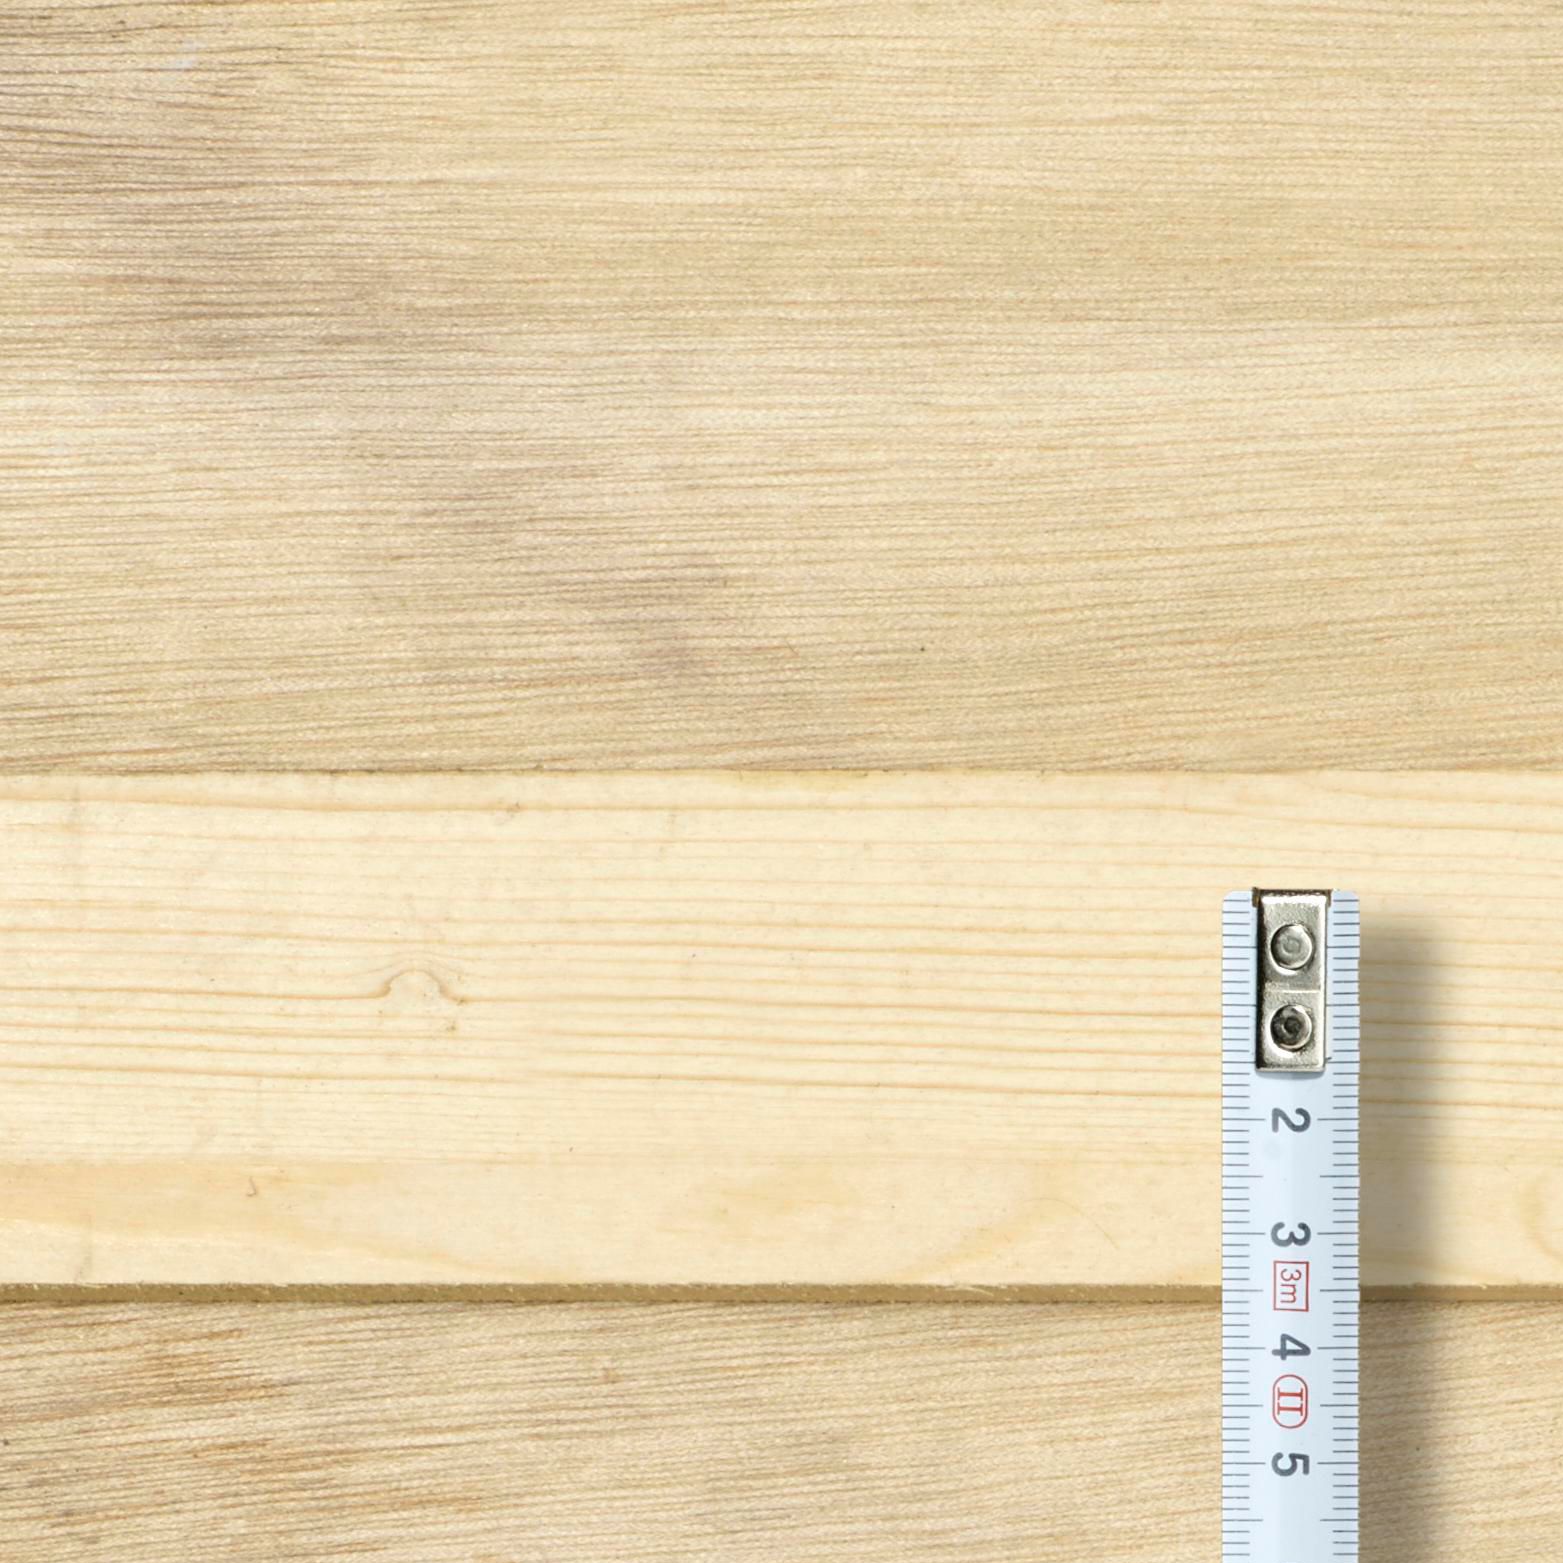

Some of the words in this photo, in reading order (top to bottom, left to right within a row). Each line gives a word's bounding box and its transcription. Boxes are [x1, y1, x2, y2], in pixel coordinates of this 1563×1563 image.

[1271, 1107, 1311, 1133] 2
[1270, 1222, 1312, 1247] 3
[1280, 1268, 1302, 1304] 3m
[1271, 1333, 1312, 1361] 4
[1277, 1386, 1304, 1416] II
[1271, 1452, 1311, 1477] 5
